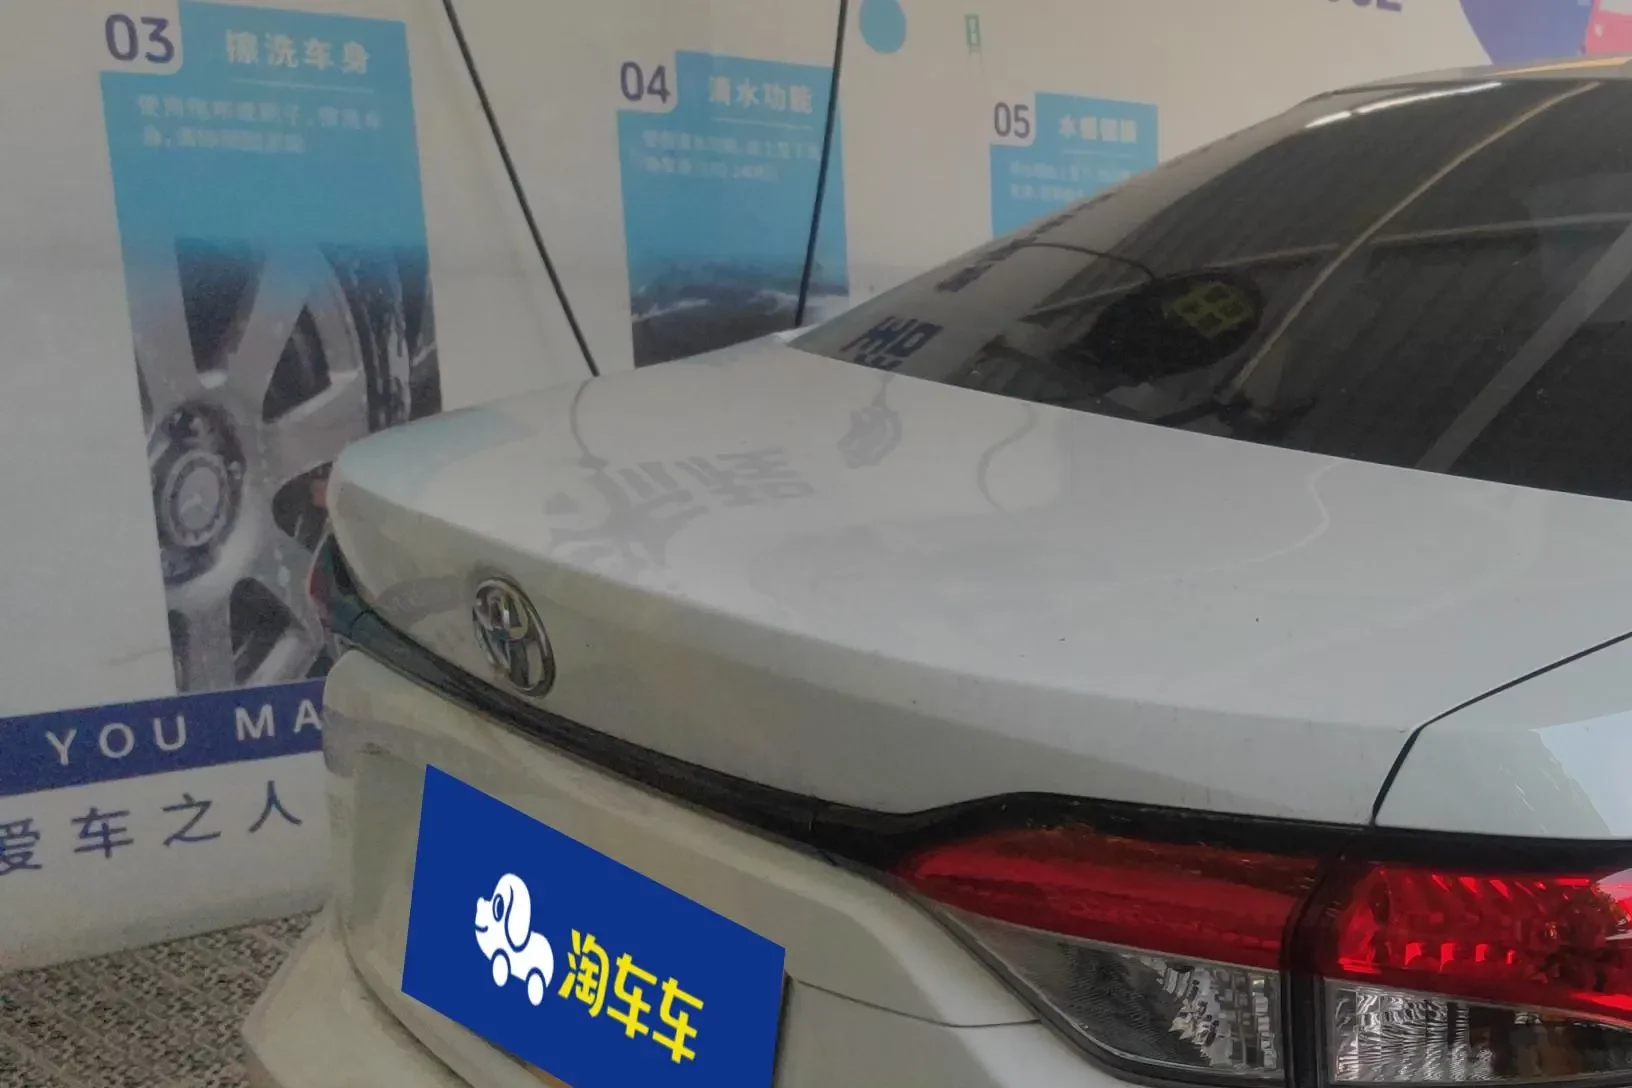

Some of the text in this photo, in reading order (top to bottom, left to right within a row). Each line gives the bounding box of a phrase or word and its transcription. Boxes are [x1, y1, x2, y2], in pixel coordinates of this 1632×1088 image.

[105, 14, 175, 63] 03
[620, 61, 670, 104] 04
[994, 102, 1030, 139] 05
[46, 715, 187, 766] YOU
[0, 780, 302, 875] 爱车之人
